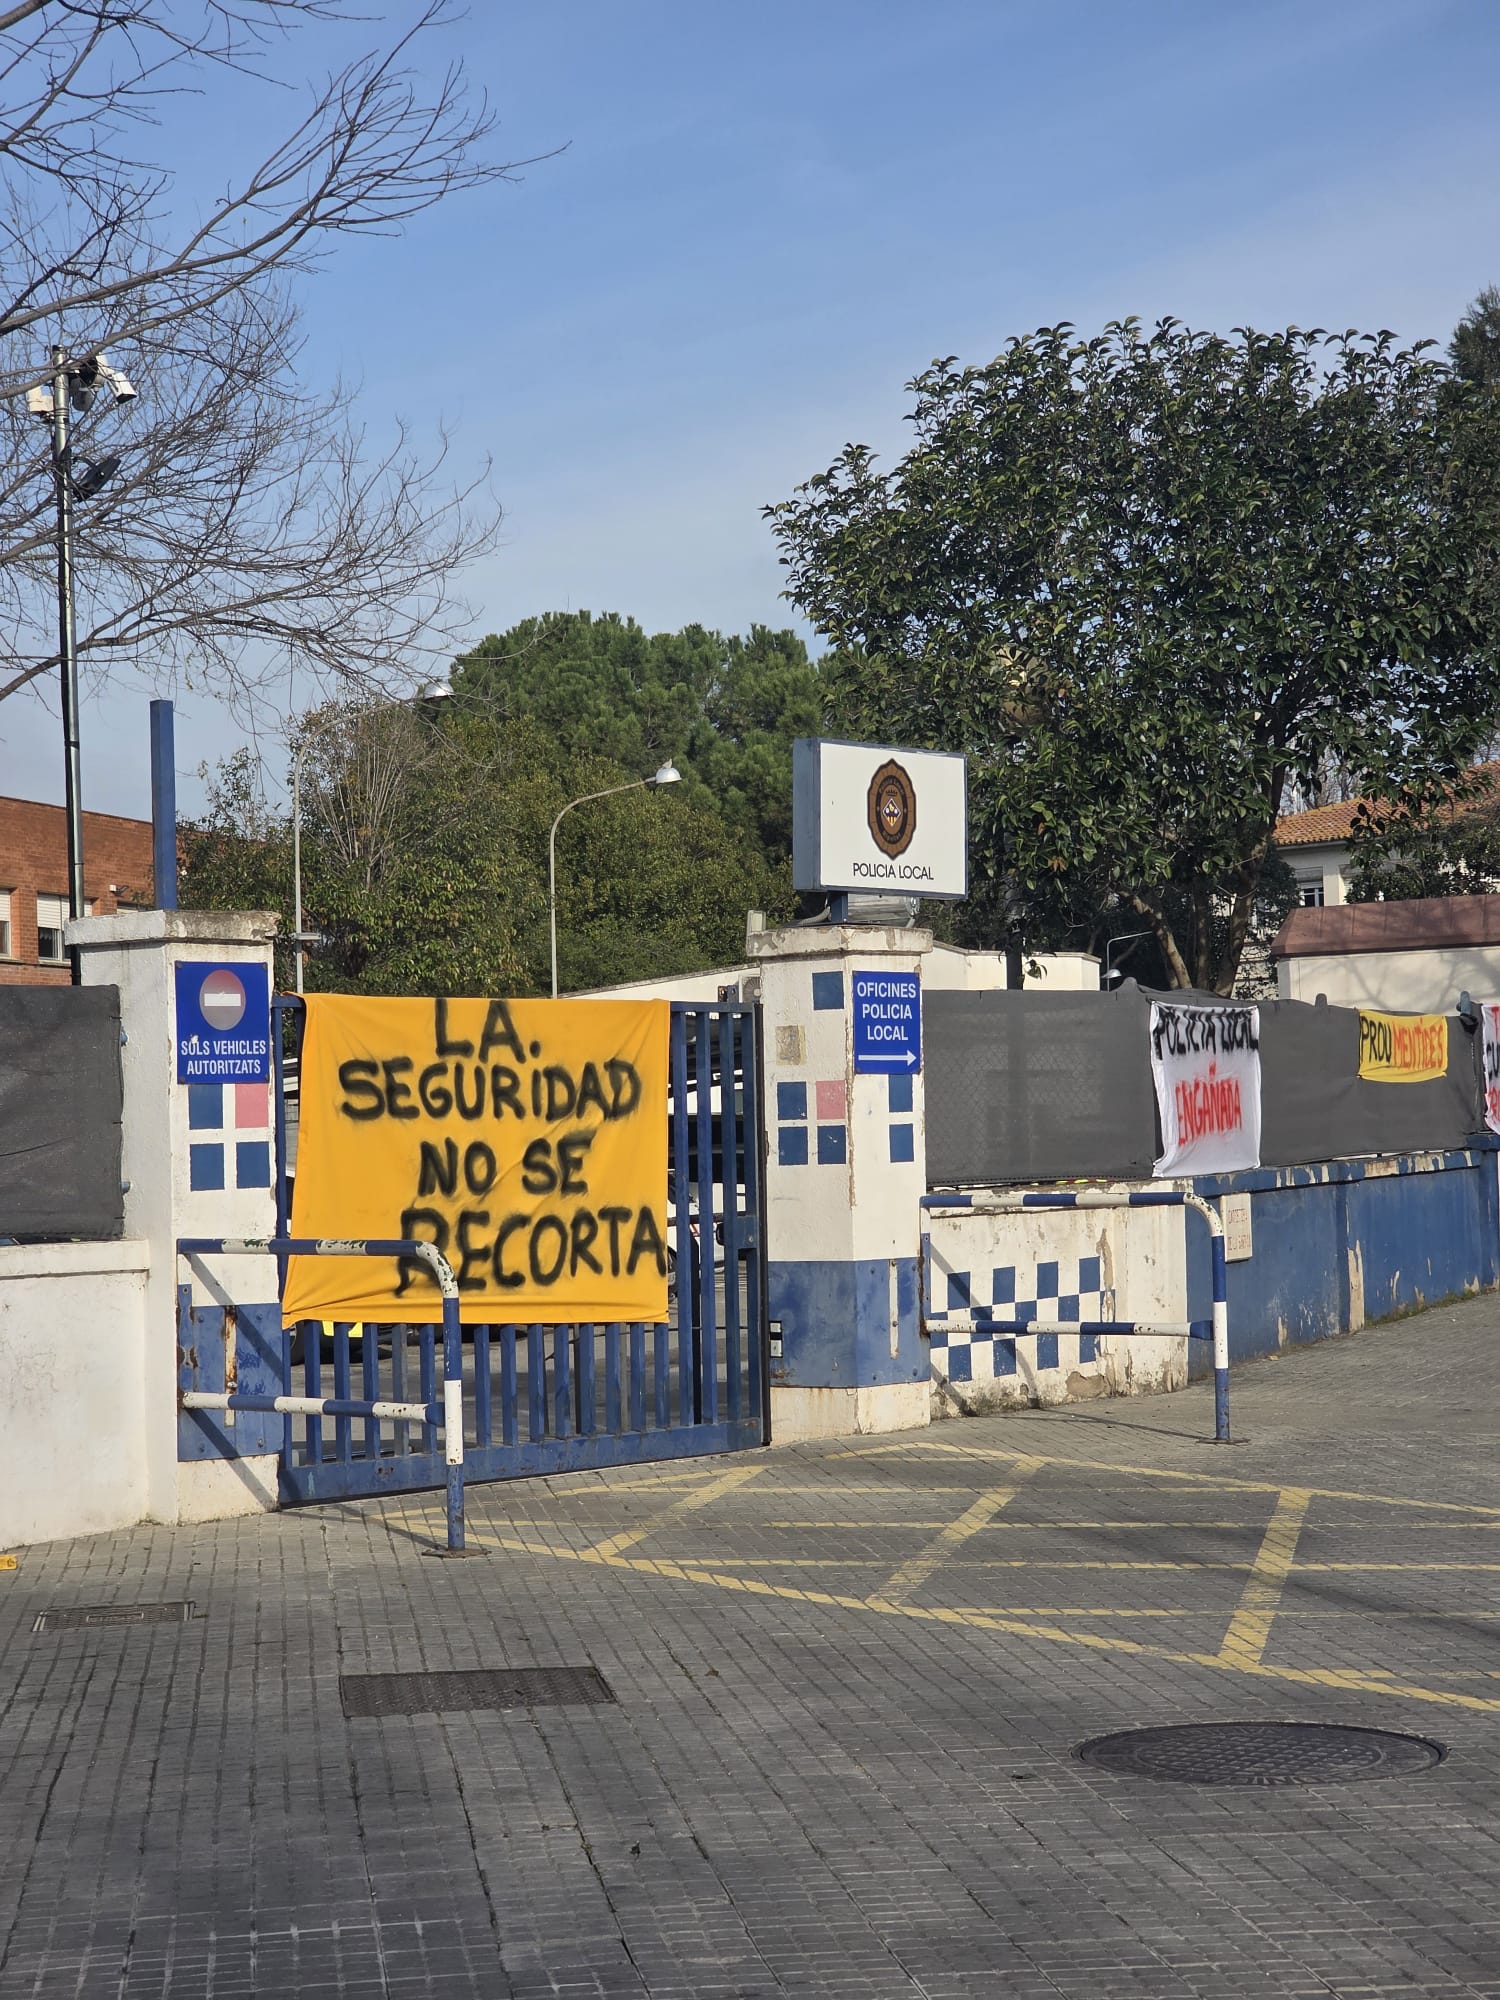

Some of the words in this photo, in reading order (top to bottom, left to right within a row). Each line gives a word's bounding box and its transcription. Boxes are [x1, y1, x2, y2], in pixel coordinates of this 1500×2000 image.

[852, 862, 897, 879] POLICIA
[898, 865, 935, 881] LOCAL
[857, 981, 917, 998] OFICINES
[862, 1003, 913, 1019] POLICIA
[867, 1025, 909, 1041] LOCAL
[1153, 1006, 1216, 1060] POLICIA
[1219, 1008, 1259, 1053] LOCAL
[1360, 1015, 1392, 1063] PROU
[181, 1040, 210, 1056] SOLS
[213, 1039, 266, 1056] VEHICLES
[187, 1059, 261, 1076] AUTORITZATS
[418, 1137, 498, 1197] NO
[521, 1129, 597, 1197] SE
[393, 1205, 666, 1297] RECORTA
